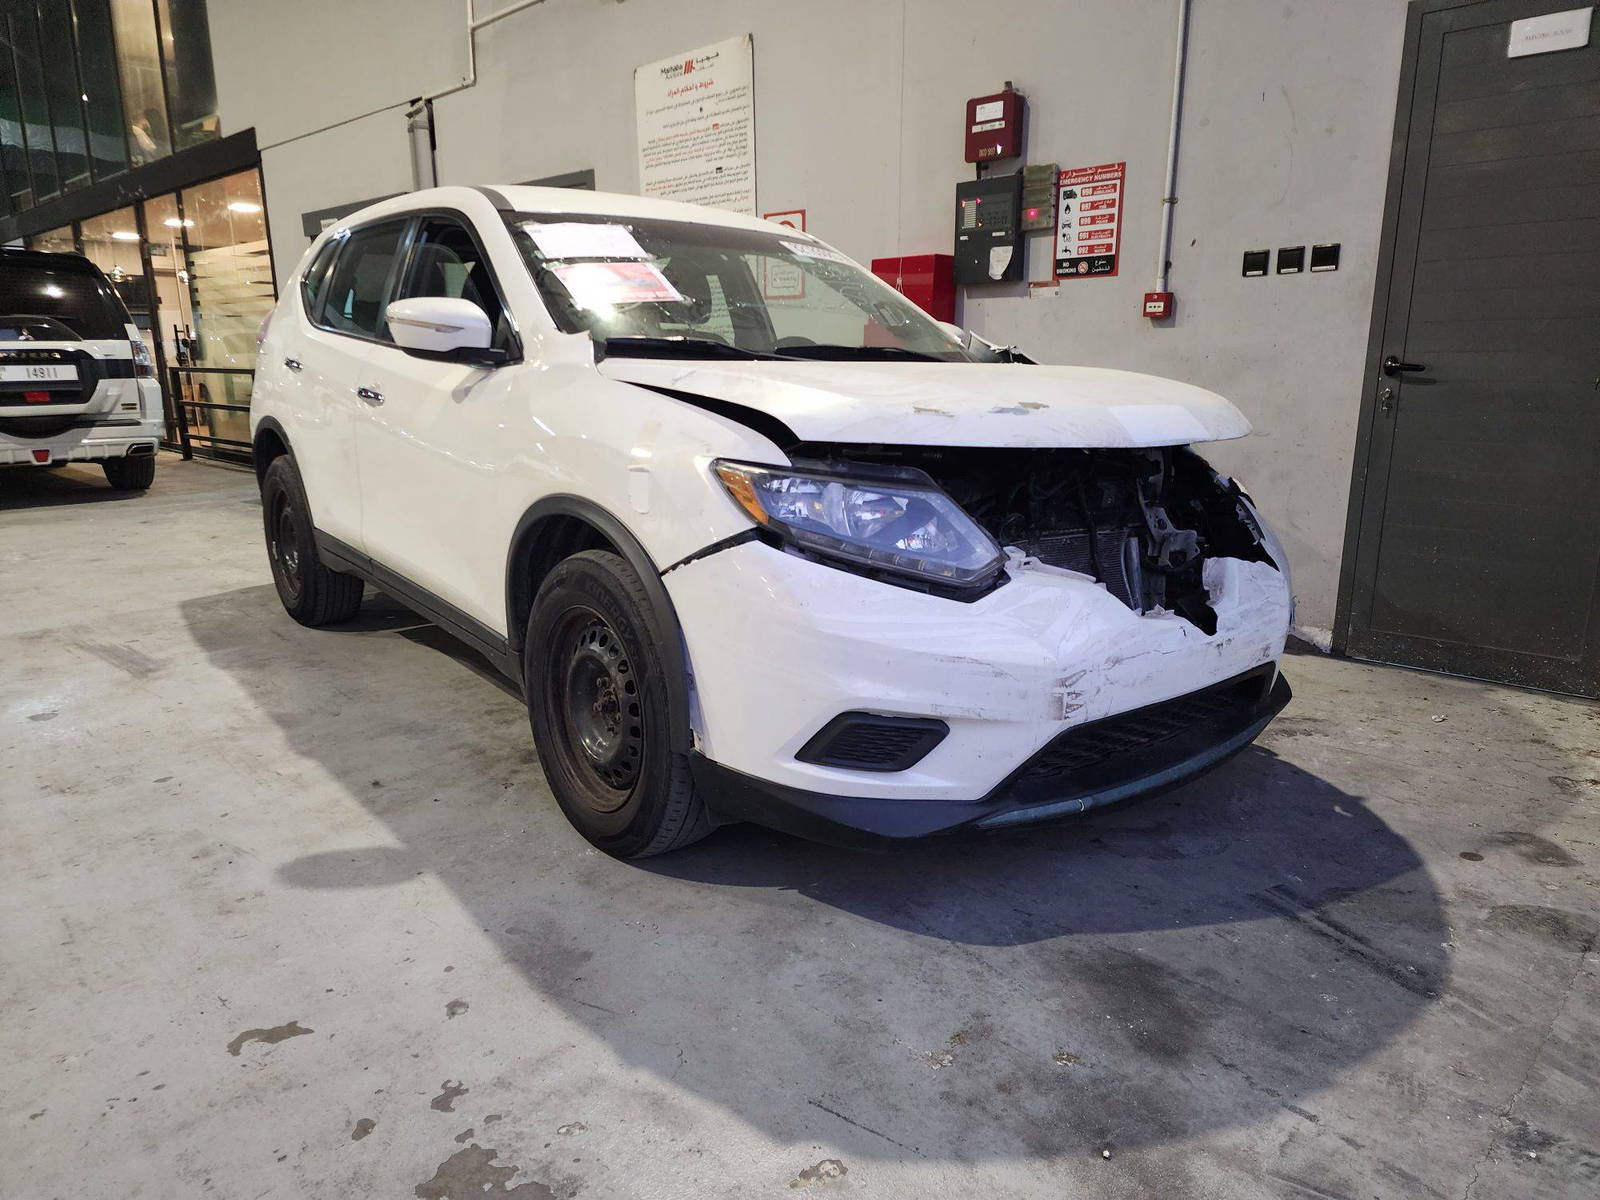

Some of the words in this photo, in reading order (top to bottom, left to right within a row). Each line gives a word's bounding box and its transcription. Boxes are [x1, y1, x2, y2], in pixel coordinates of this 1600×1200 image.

[1060, 175, 1094, 185] EMERGENCY
[1094, 171, 1121, 181] NUMBERS
[26, 367, 58, 379] 14911
